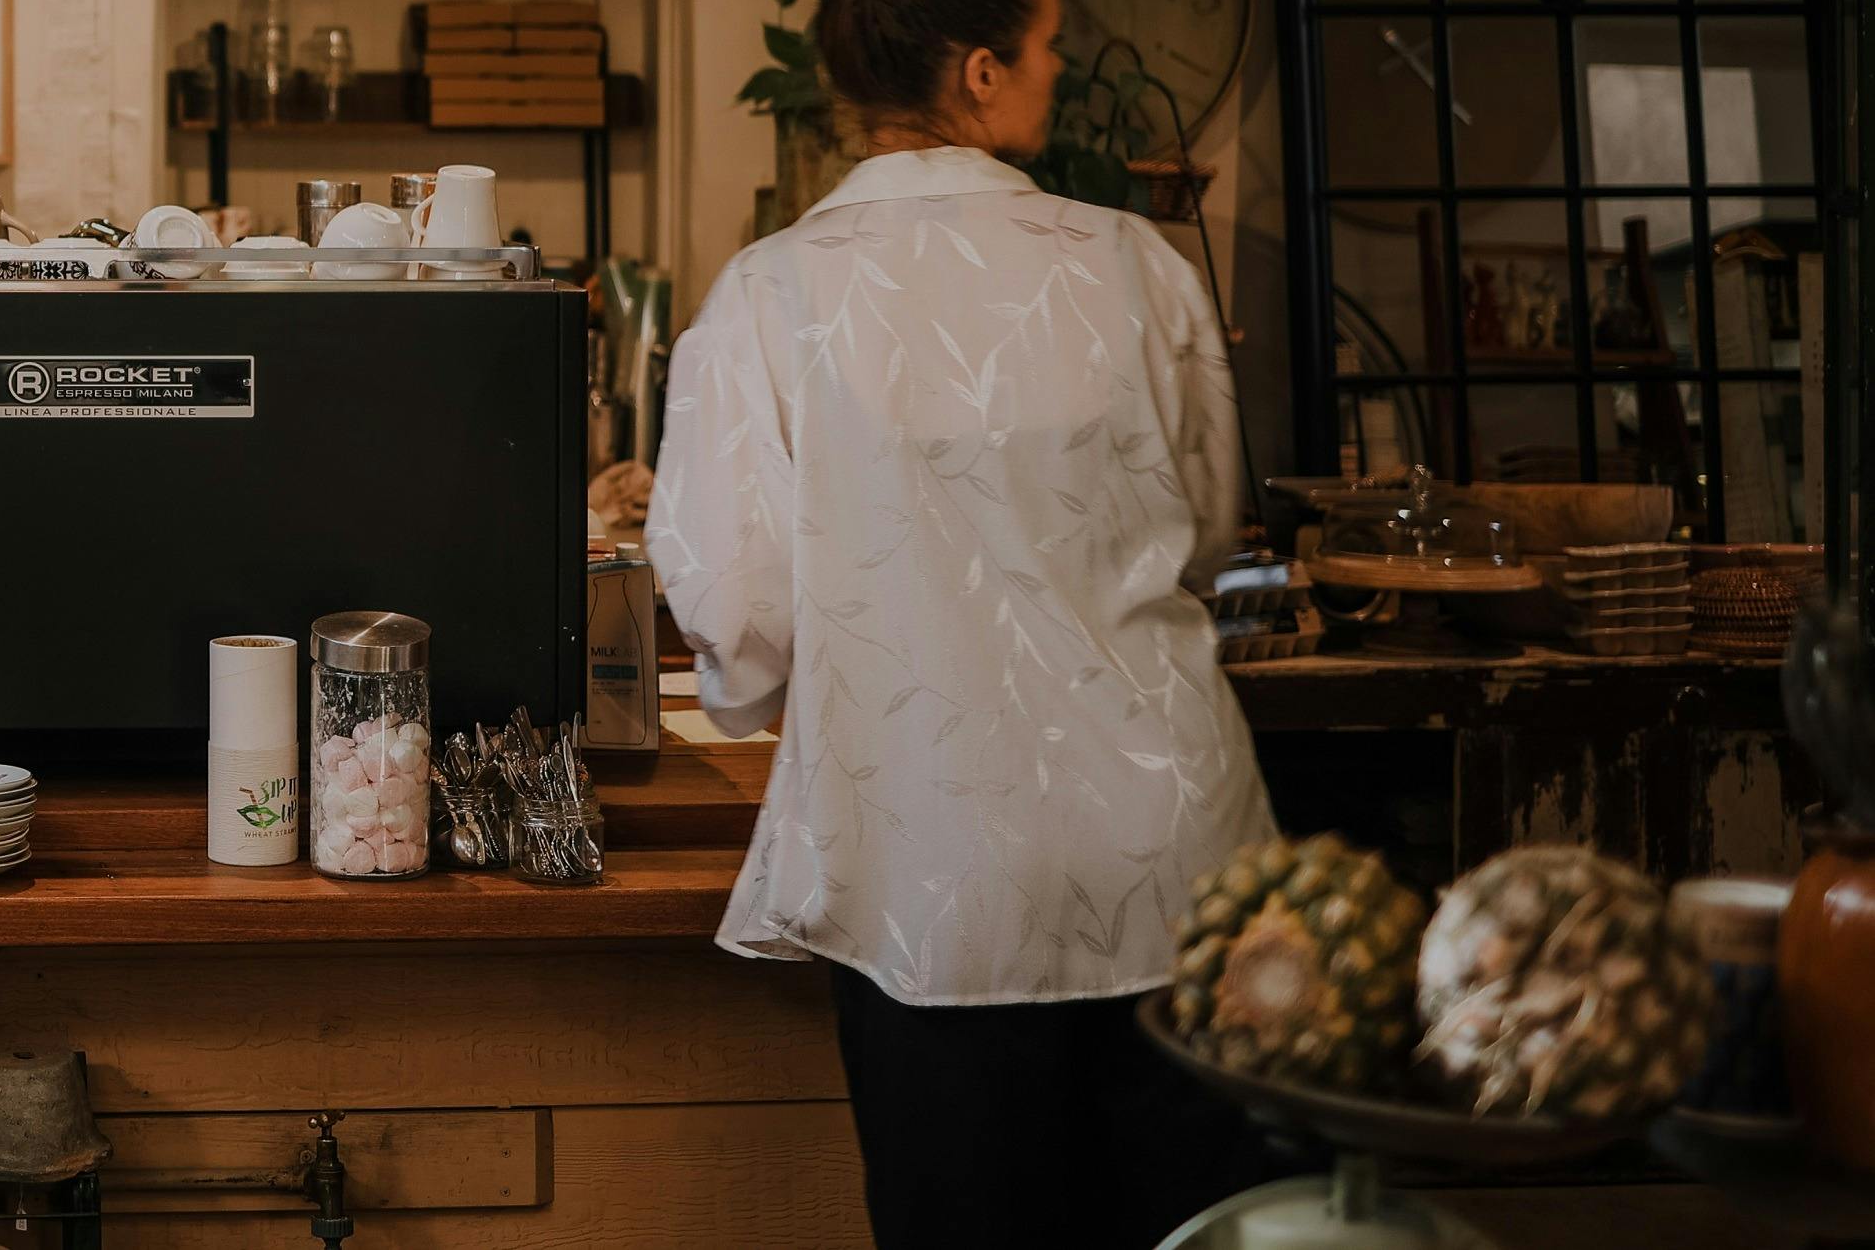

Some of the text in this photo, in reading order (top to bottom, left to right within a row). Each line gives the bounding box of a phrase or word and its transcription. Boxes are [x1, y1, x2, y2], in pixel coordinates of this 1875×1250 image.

[56, 367, 193, 383] ROCKET
[56, 389, 194, 398] ESPRESSO MILANO
[4, 408, 197, 416] LINEA PROFESSIONALE
[257, 777, 286, 806] SIP
[281, 798, 297, 824] UP
[244, 830, 272, 838] WHEAT
